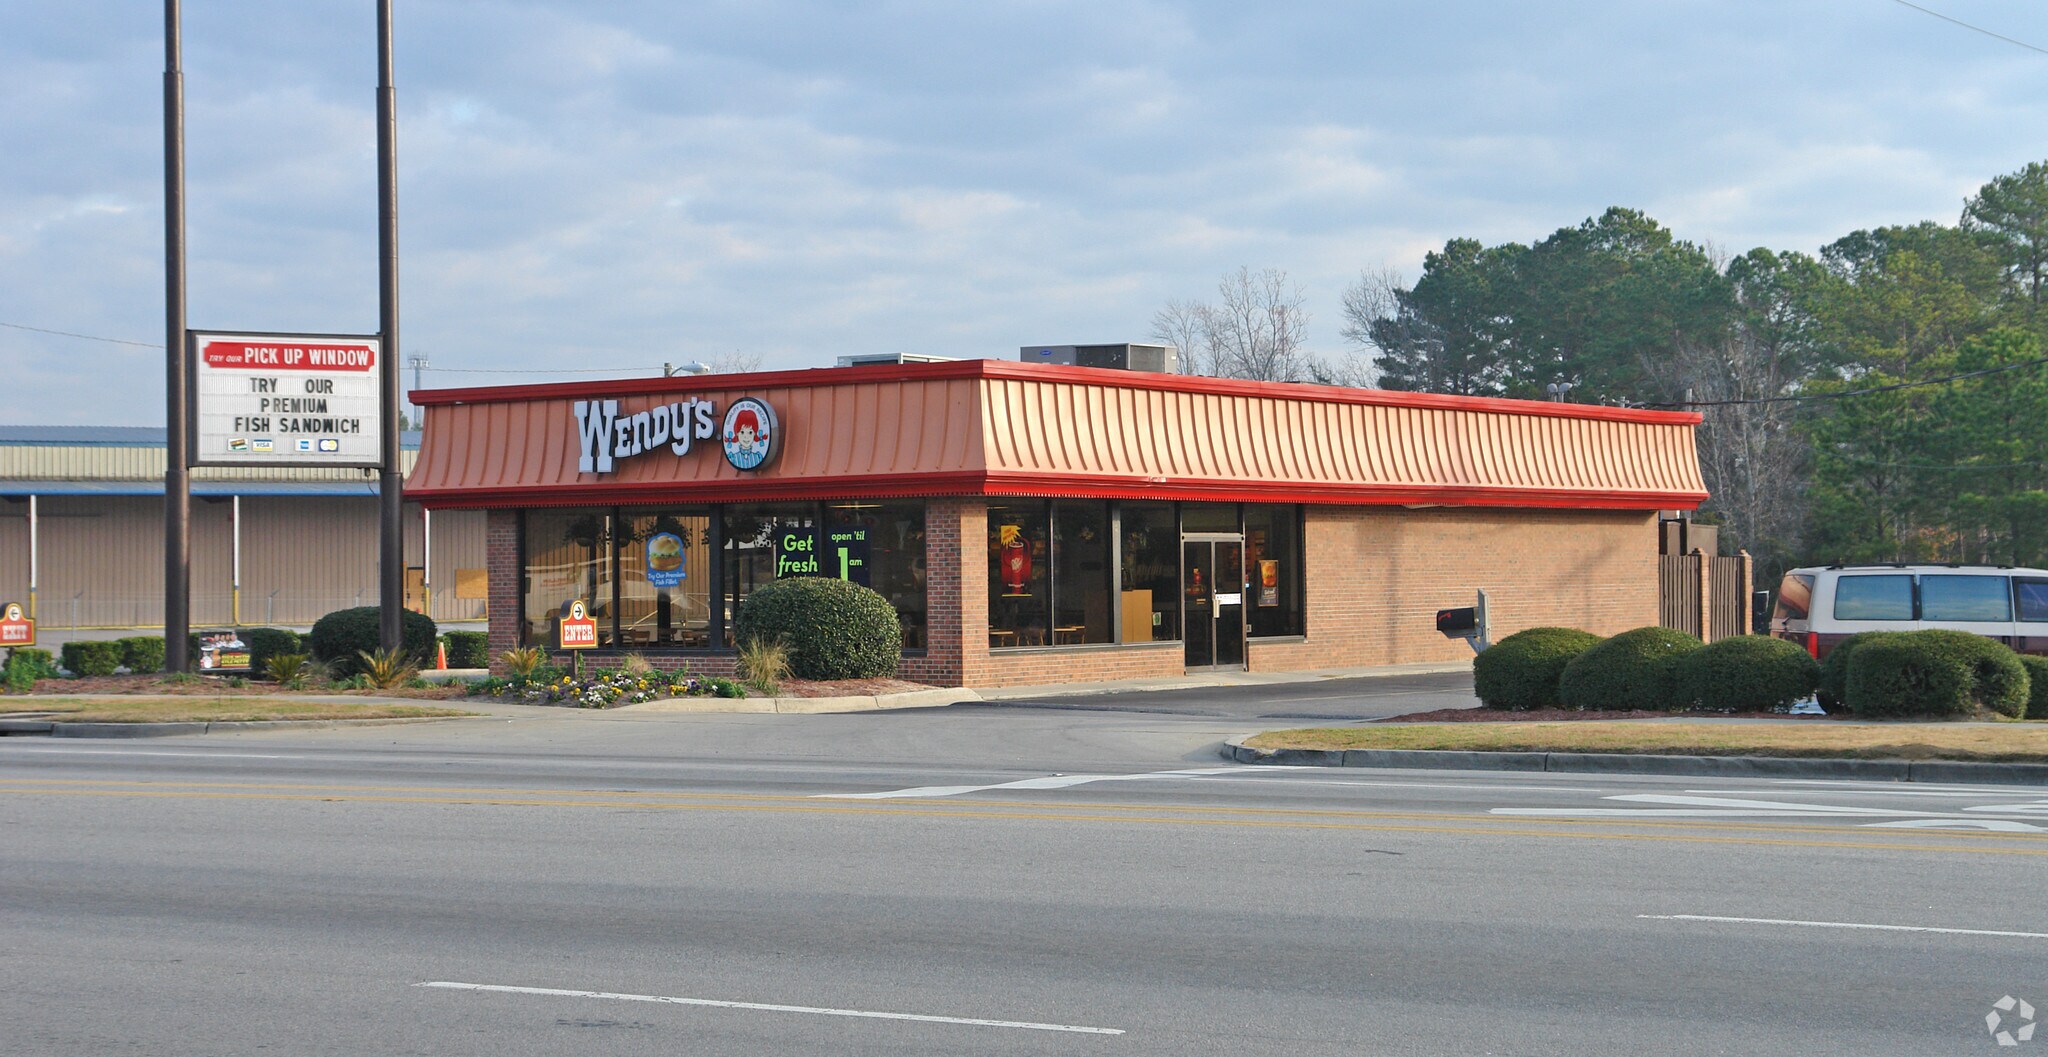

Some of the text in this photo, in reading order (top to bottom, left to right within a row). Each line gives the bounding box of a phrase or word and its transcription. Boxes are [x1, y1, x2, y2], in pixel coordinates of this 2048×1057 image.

[208, 347, 369, 366] TRY OUR PICK UP WINDOW
[250, 377, 333, 394] TRY OUR
[260, 398, 328, 414] PREMIUM
[234, 416, 360, 434] FISH SANDWICH
[726, 406, 739, 426] QUALITY
[783, 534, 814, 552] Get
[831, 532, 852, 543] open
[777, 554, 818, 578] fresh
[849, 558, 863, 566] am
[2, 624, 27, 640] EXIT
[564, 624, 594, 642] ENTER
